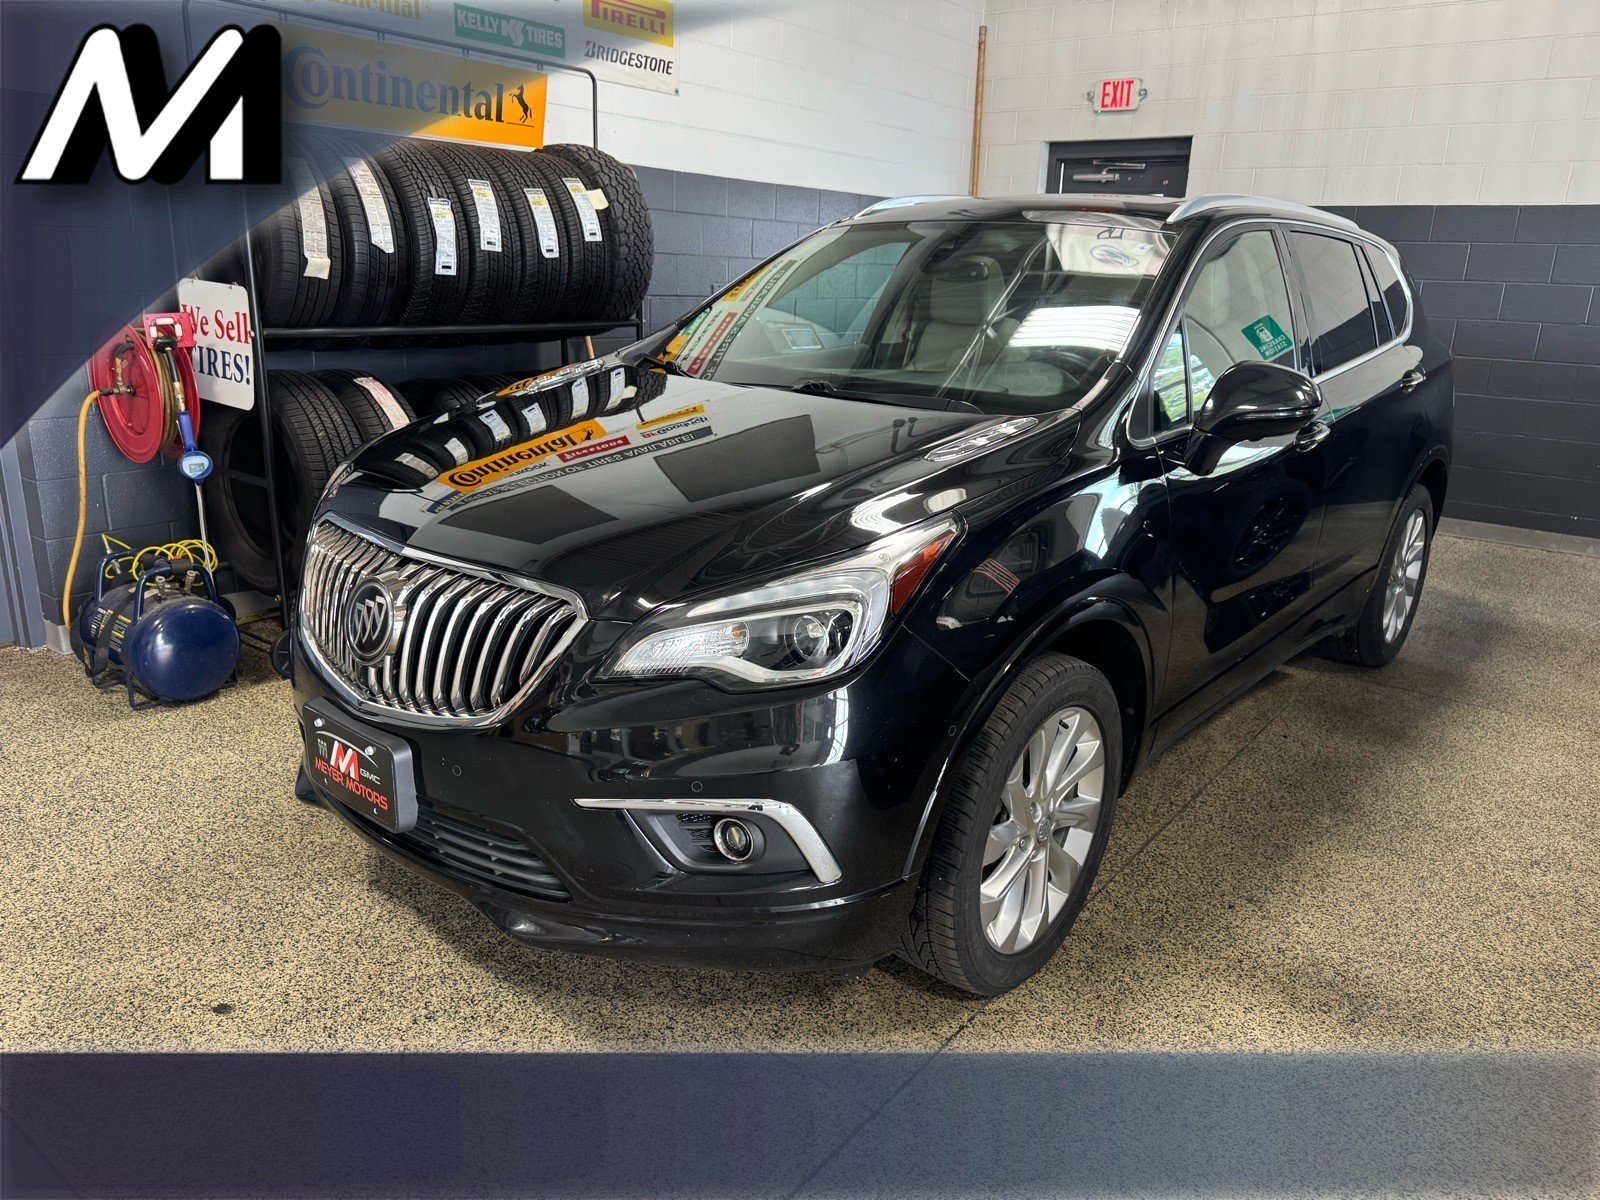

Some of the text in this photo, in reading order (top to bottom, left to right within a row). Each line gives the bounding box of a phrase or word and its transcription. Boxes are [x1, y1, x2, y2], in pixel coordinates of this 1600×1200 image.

[457, 10, 500, 34] KELLY
[527, 27, 563, 49] TIRES
[591, 0, 666, 35] PIRELLI
[584, 40, 673, 75] BRIDGESTONE
[283, 45, 504, 123] Continental
[1101, 80, 1134, 108] EXIT
[181, 304, 250, 344] We Sell
[193, 341, 250, 385] IRES!
[315, 756, 388, 811] MEYER MOTORS
[360, 767, 381, 785] GMC
